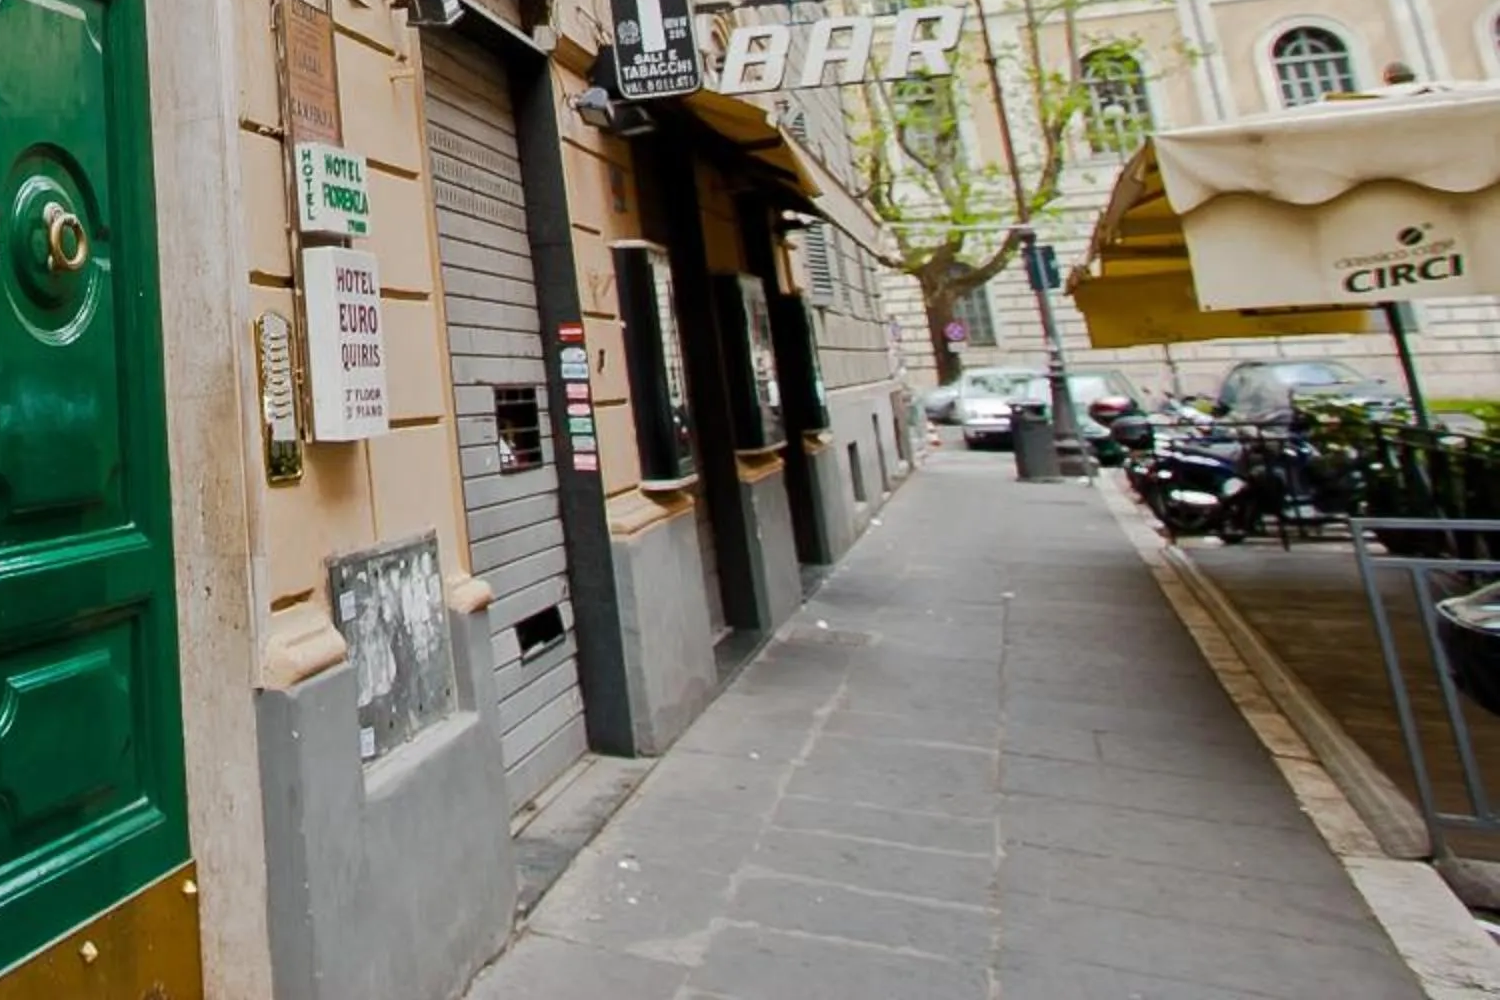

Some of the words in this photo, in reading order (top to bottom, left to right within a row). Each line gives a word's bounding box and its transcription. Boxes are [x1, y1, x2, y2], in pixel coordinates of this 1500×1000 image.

[667, 48, 678, 61] E
[719, 5, 968, 94] BAR
[622, 59, 693, 80] TABACCHI
[323, 153, 363, 183] HOTEL
[301, 148, 316, 221] HOTEL
[335, 267, 376, 295] HOTEL
[1344, 253, 1464, 293] CIRCI
[339, 303, 378, 334] EURO
[341, 343, 381, 372] QUIRIS
